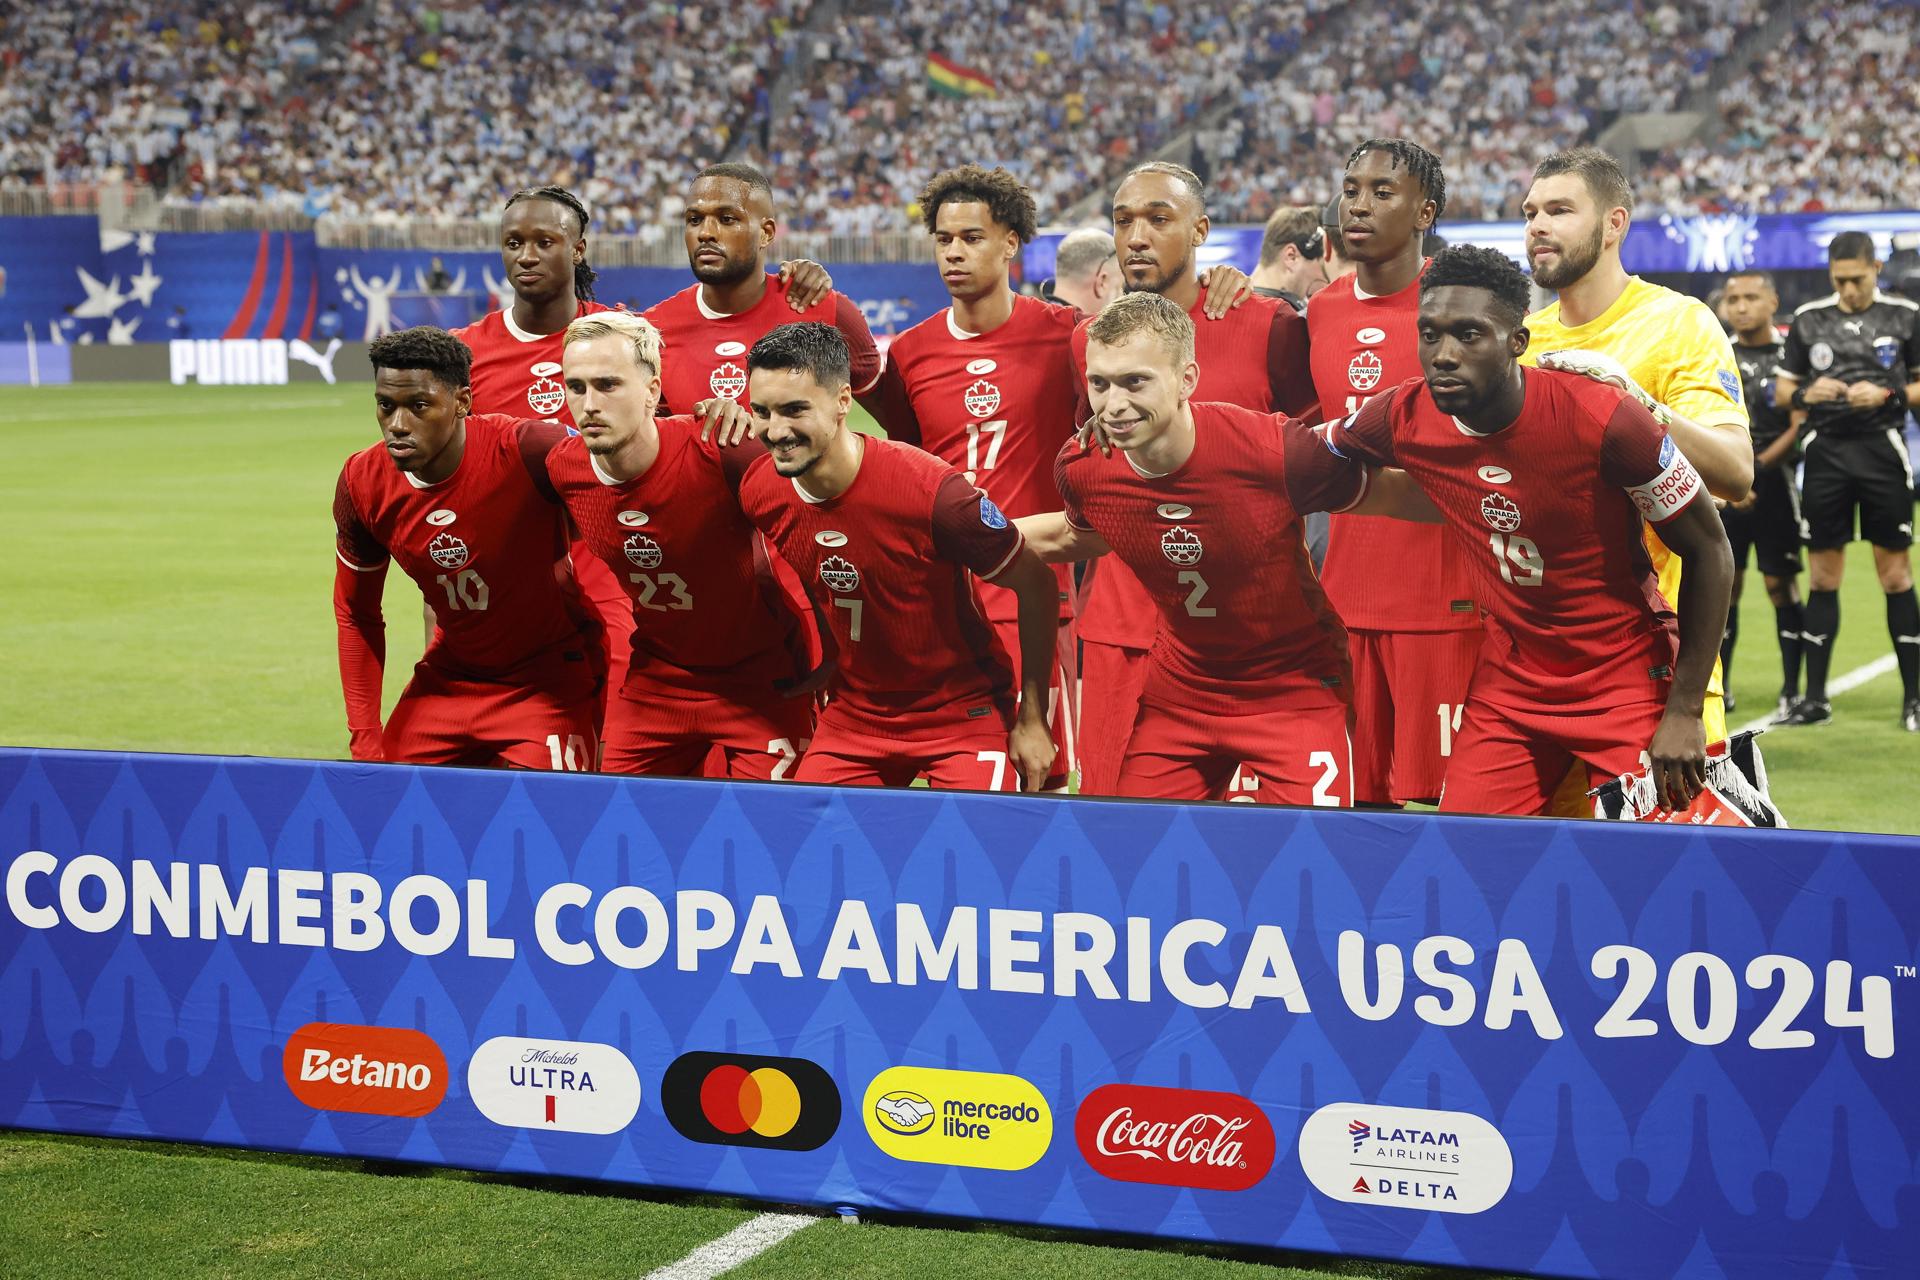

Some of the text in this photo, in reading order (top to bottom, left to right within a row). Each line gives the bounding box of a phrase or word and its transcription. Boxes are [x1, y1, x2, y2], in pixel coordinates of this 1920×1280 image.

[170, 339, 288, 385] PUMA
[529, 391, 563, 402] CANADA
[711, 378, 745, 386] CANADA
[966, 395, 999, 404] CANADA
[966, 420, 1008, 471] 17
[1651, 459, 1688, 497] CHOOSE
[1658, 468, 1698, 508] TO INCLU
[1483, 508, 1519, 520] CANADA
[431, 547, 467, 558] CANADA
[626, 549, 661, 557] CANADA
[1163, 544, 1201, 552] CANADA
[1488, 533, 1545, 587] 19
[436, 568, 489, 611] 10
[629, 572, 693, 612] 23
[821, 571, 858, 580] CANADA
[1177, 570, 1217, 617] 2
[834, 597, 863, 642] 7
[545, 734, 588, 772] 10
[766, 738, 811, 781] 2
[976, 750, 1007, 791] 7
[1308, 751, 1341, 807] 2
[6, 850, 515, 960] CONMEBOL
[534, 882, 804, 978] COPA
[816, 899, 1312, 1014] AMERICA
[1337, 929, 1564, 1041] USA
[1591, 944, 1894, 1059] 2024
[300, 1048, 431, 1091] Betano
[521, 1048, 579, 1065] Michelob
[509, 1065, 597, 1092] ULTRA
[943, 1099, 1040, 1123] mercado
[943, 1117, 991, 1140] libre
[1096, 1107, 1252, 1168] Coca-Cola
[1376, 1127, 1459, 1147] LATAM
[1376, 1148, 1460, 1164] AIRLINES
[1378, 1179, 1458, 1201] DELTA
